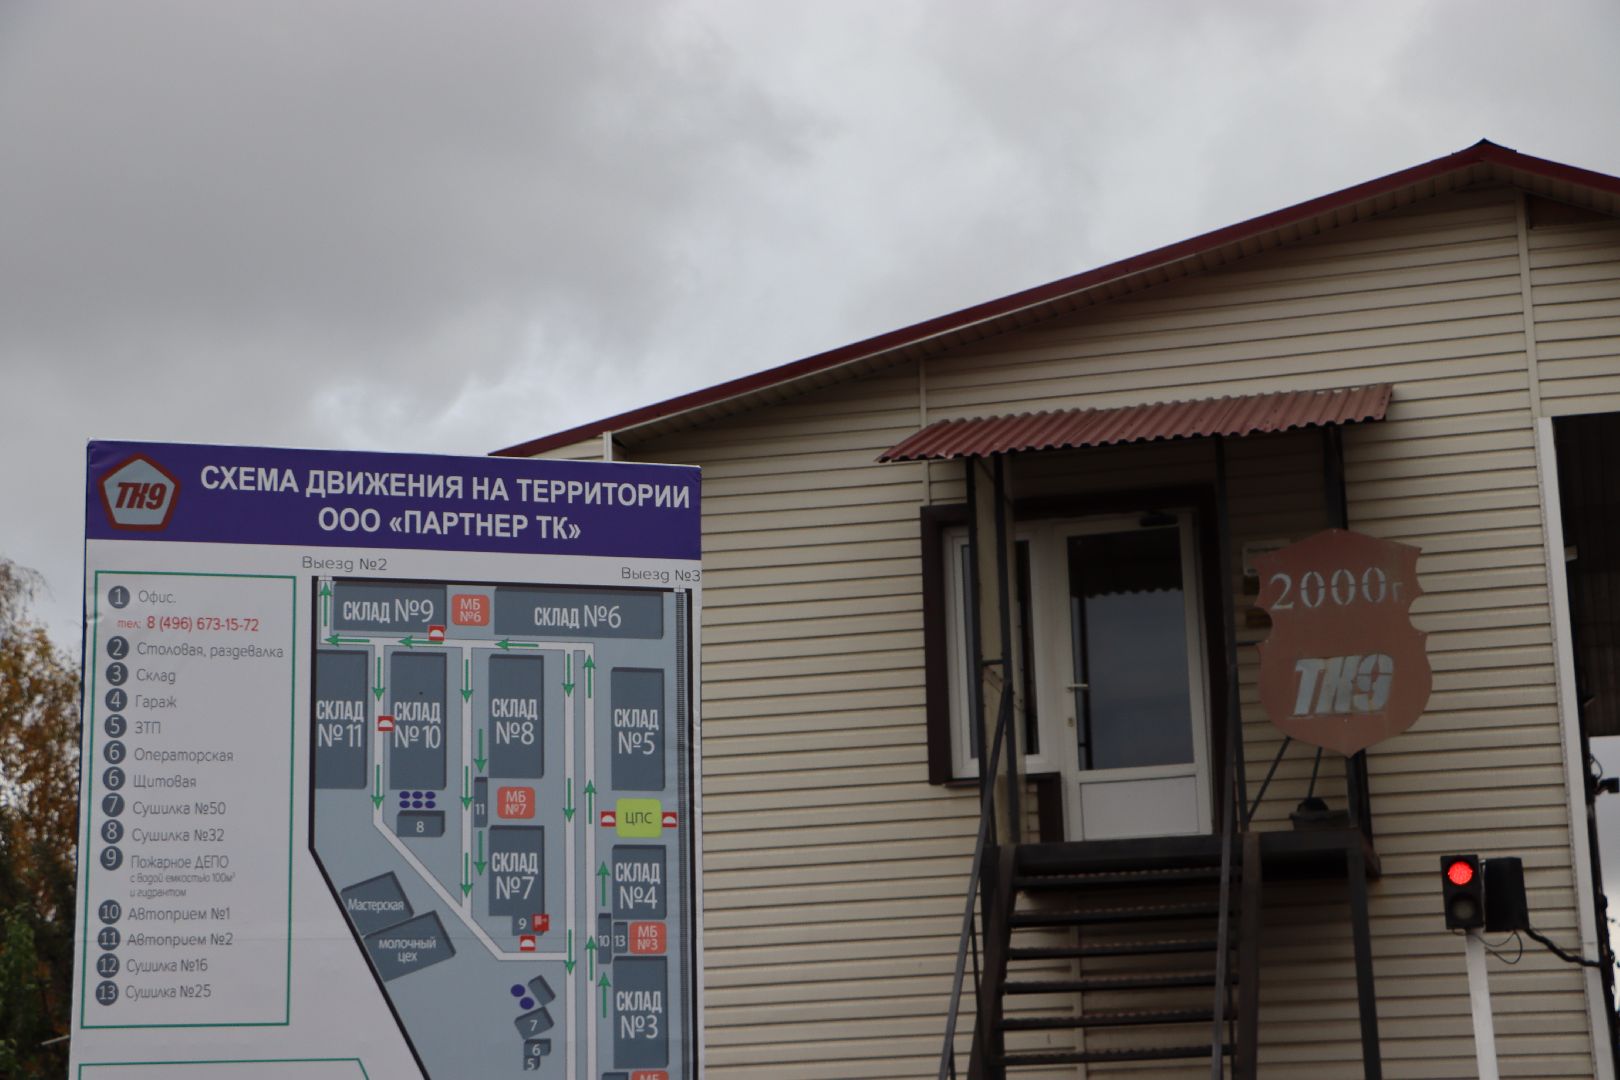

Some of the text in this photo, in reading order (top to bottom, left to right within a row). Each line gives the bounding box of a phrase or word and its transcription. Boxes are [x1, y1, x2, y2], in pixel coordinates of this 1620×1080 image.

[115, 482, 167, 510] ТК9
[201, 466, 690, 509] СХЕМА ДВИЖЕНИЯ НА ТЕРРИТОРИИ
[318, 508, 580, 540] ООО «ПАРТНЕР ТК»
[303, 556, 387, 572] Выезд №2
[621, 567, 701, 584] Выезд №3
[115, 589, 176, 604] 1 Офис.
[460, 598, 480, 611] МБ
[343, 599, 434, 623] СКЛАД №9
[459, 610, 481, 623] №6
[534, 605, 622, 629] СКЛАД №6
[147, 616, 155, 629] 8
[160, 616, 192, 632] (496)
[197, 618, 259, 631] 673-15-72
[112, 639, 284, 660] 2 Столовая, раздевалка
[111, 665, 176, 684] 3 Склад
[111, 691, 176, 710] 4 Гараж
[492, 698, 537, 721] СКЛАД
[316, 700, 364, 723] СКЛАД
[394, 701, 441, 724] СКЛАД
[614, 708, 659, 731] СКЛАД
[109, 717, 120, 734] 5
[496, 721, 535, 745] №8
[318, 723, 362, 747] №11
[395, 724, 441, 748] №10
[618, 732, 655, 755] №5
[110, 743, 233, 763] 6 Операторская
[109, 770, 196, 789] 6 Щитовая
[506, 791, 526, 803] МБ
[108, 796, 226, 817] 7 Сушилка №50
[475, 803, 486, 815] 11
[505, 803, 527, 815] №7
[416, 820, 424, 833] 8
[625, 811, 653, 825] ЦПС
[107, 822, 224, 844] 8 Сушилка №32
[106, 849, 229, 870] 9 Пожарное ДЕПО
[492, 852, 538, 874] СКЛАД
[615, 862, 661, 884] СКЛАД
[496, 876, 534, 899] №7
[348, 898, 405, 913] Мастерская
[620, 886, 657, 910] №4
[102, 905, 230, 923] 10 Автоприем №1
[519, 917, 527, 931] 9
[638, 926, 657, 937] МБ
[101, 932, 233, 949] 11 Автоприем №2
[379, 937, 436, 951] молочный
[599, 935, 610, 947] 10
[615, 935, 625, 946] 13
[637, 939, 658, 950] №3
[100, 958, 207, 975] 12 Сушилка №16
[397, 951, 417, 964] цех
[99, 985, 211, 1001] 13 Сушилка №25
[617, 991, 662, 1013] СКЛАД
[530, 1020, 537, 1031] 7
[621, 1015, 658, 1039] №3
[532, 1044, 540, 1056] 6
[528, 1058, 534, 1070] 5
